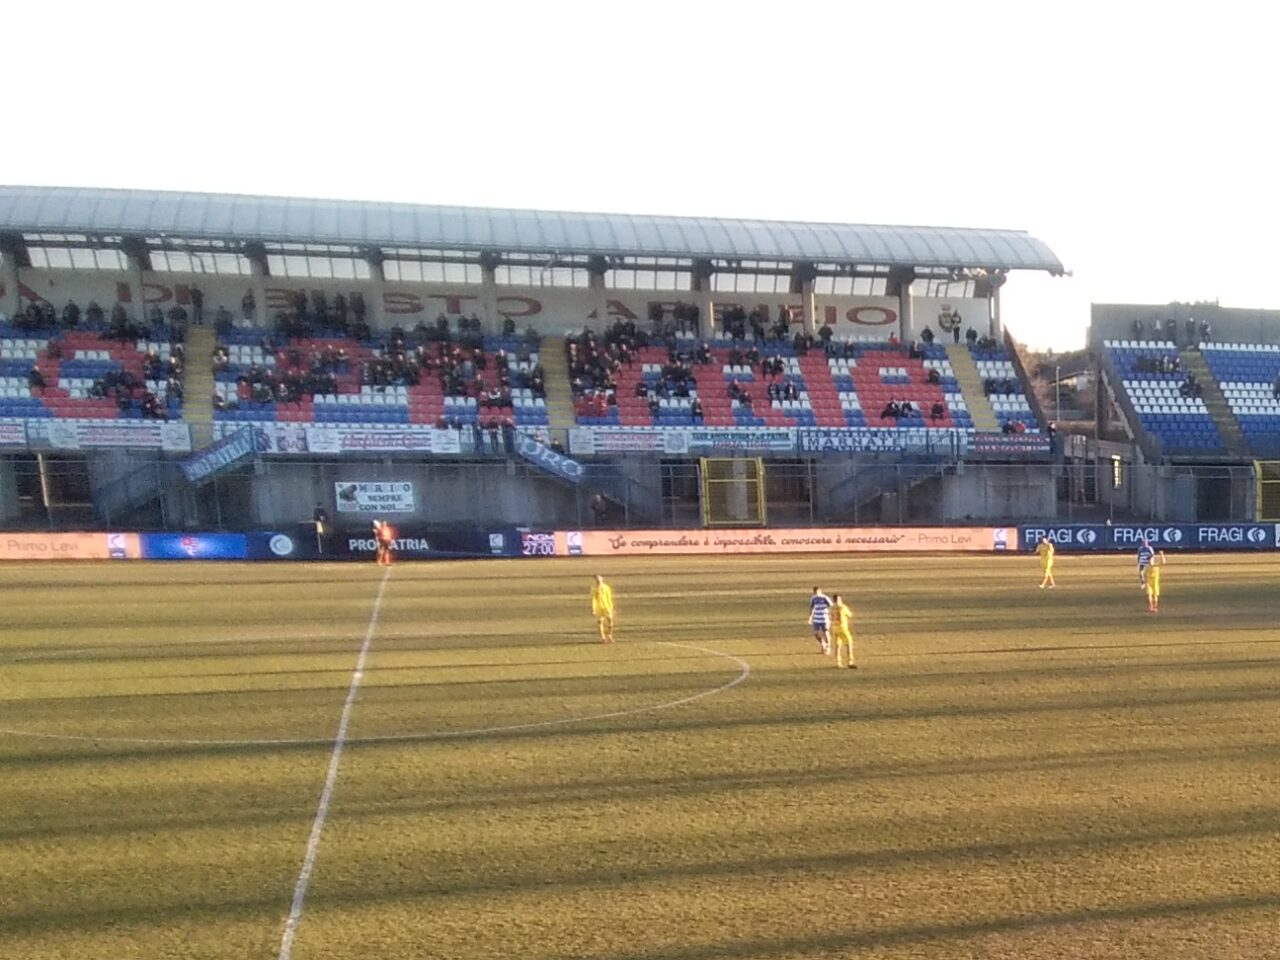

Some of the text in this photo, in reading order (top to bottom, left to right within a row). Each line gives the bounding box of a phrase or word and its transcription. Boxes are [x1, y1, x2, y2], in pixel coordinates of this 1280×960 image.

[631, 536, 699, 549] comprendere
[781, 537, 833, 546] conoscere
[918, 533, 949, 544] Primo
[951, 533, 972, 544] Levi
[1025, 528, 1072, 543] FRAGI
[1113, 528, 1159, 543] FRAGI
[1198, 527, 1243, 542] FRAGI
[8, 541, 79, 551] Primo Levi
[349, 537, 429, 551] PRO ATRIA
